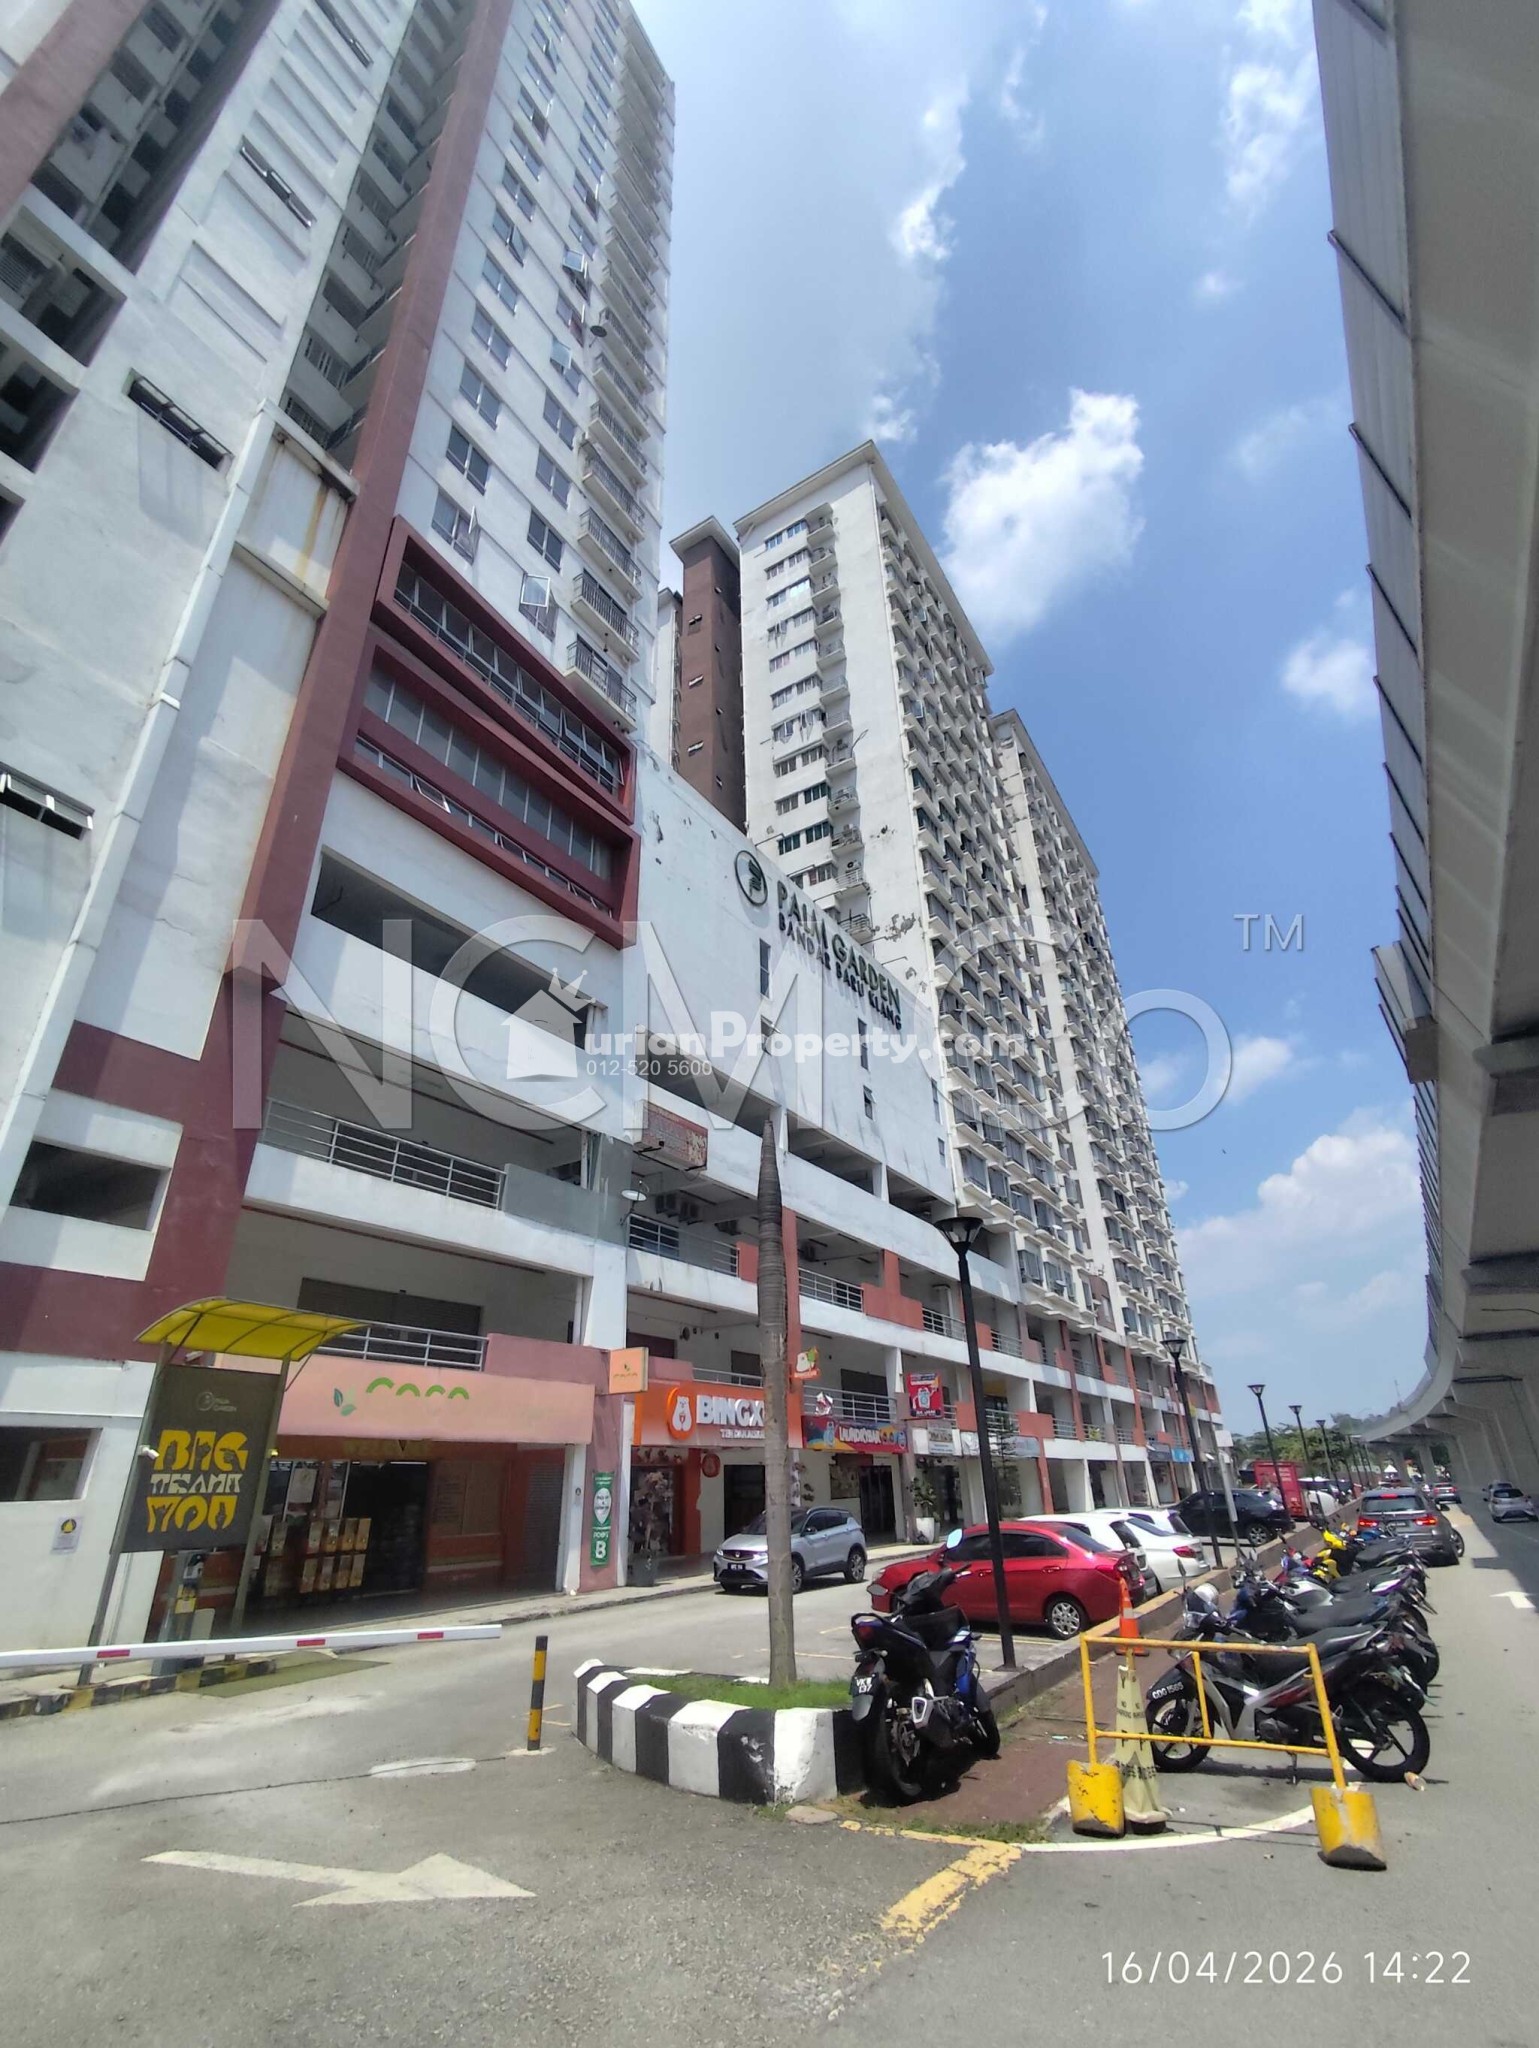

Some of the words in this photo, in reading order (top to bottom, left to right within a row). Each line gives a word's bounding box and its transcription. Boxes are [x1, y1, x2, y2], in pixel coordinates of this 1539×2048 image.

[777, 880, 829, 949] PALM
[832, 934, 901, 1014] GARDEN
[778, 912, 831, 971] BANDAR
[835, 961, 865, 997] BARU
[868, 990, 902, 1031] KLANG
[154, 1430, 248, 1472] BIG
[150, 1473, 243, 1494] THANK
[146, 1495, 238, 1533] YOU
[595, 1540, 607, 1559] B
